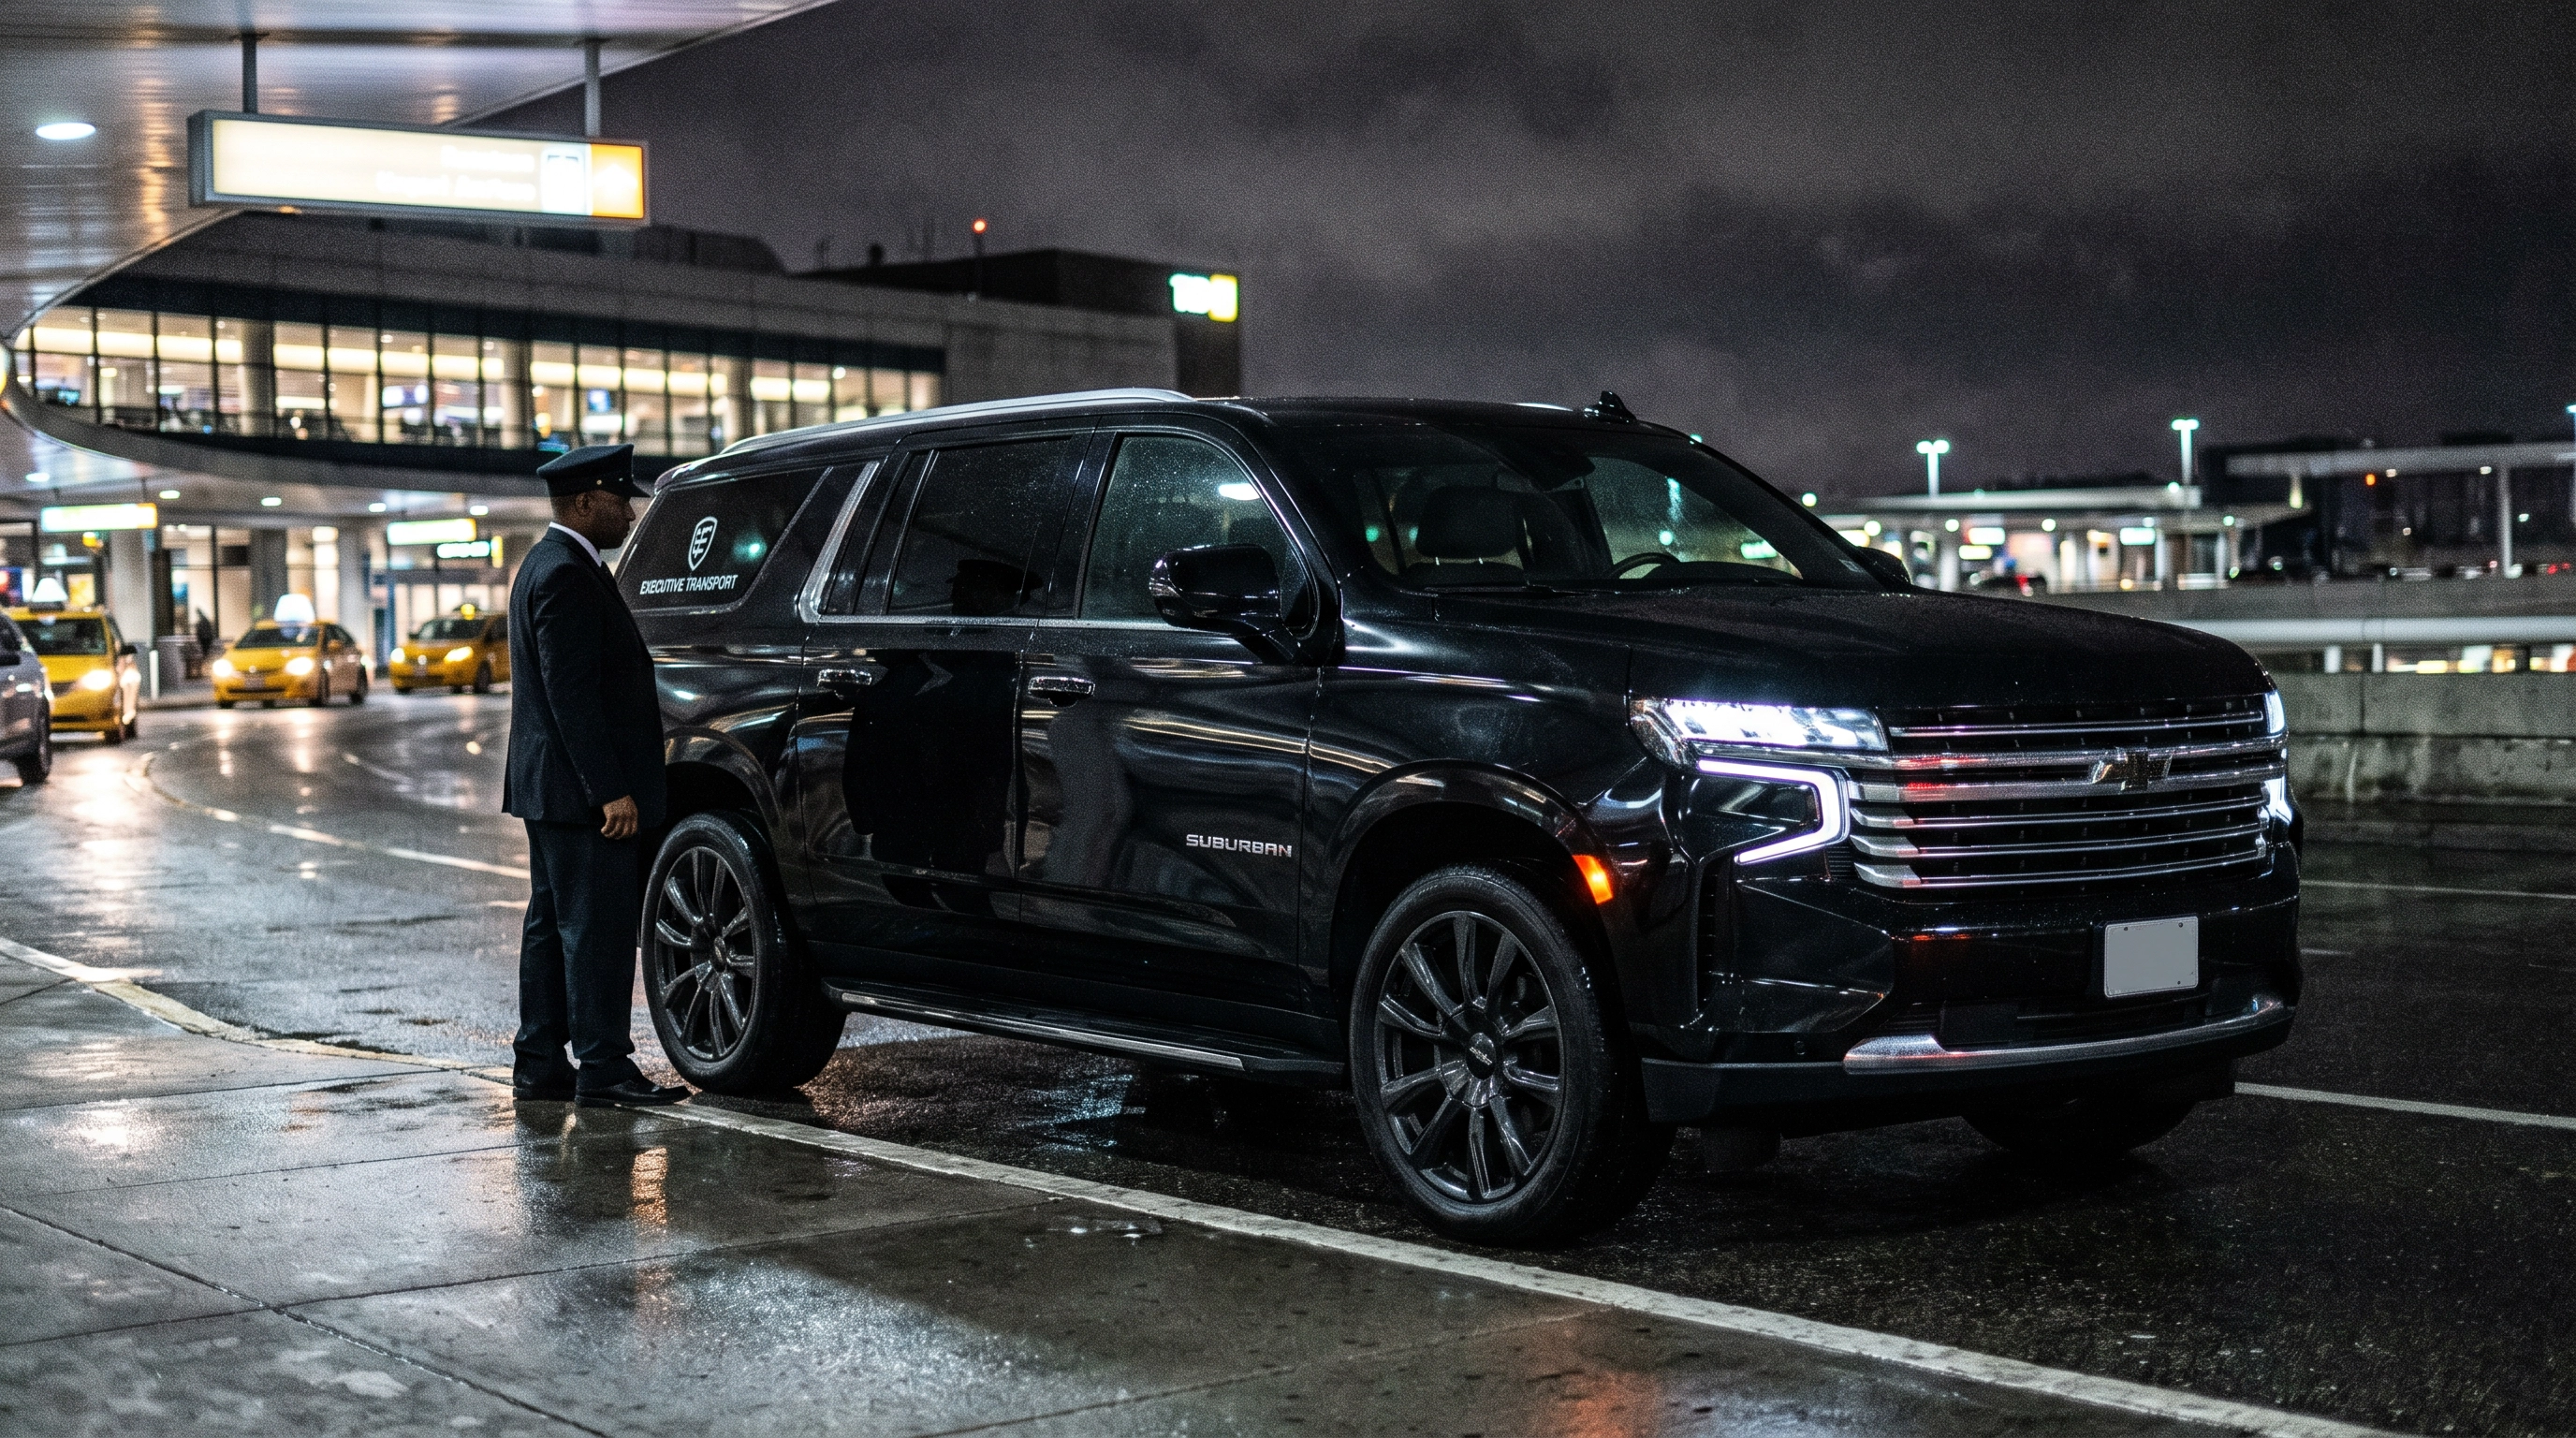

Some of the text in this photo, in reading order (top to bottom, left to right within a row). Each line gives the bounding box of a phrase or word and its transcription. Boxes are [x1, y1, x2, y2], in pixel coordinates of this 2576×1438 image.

[639, 575, 739, 594] EXECUTIVE TRANSPORT
[1185, 834, 1292, 858] SUBURBAN
